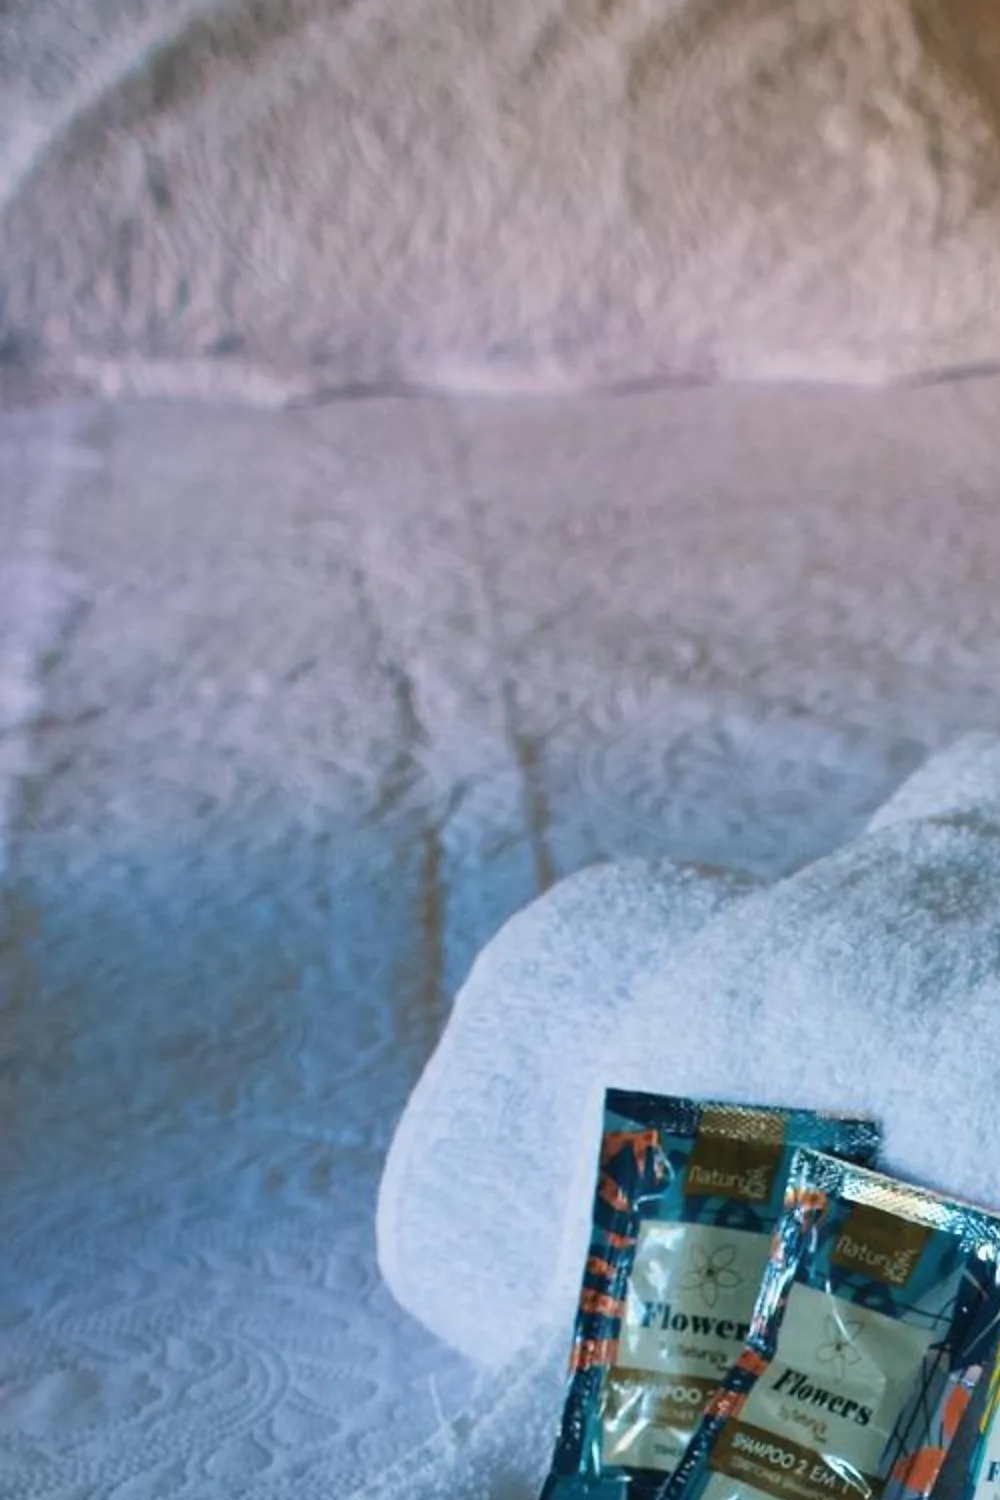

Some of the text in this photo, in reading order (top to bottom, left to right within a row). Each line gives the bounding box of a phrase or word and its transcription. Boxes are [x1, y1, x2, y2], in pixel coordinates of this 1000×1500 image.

[641, 1302, 747, 1342] Flower
[771, 1368, 874, 1427] Flowers
[730, 1432, 796, 1468] SHAMPOO
[794, 1459, 808, 1476] 2
[809, 1465, 836, 1488] EM
